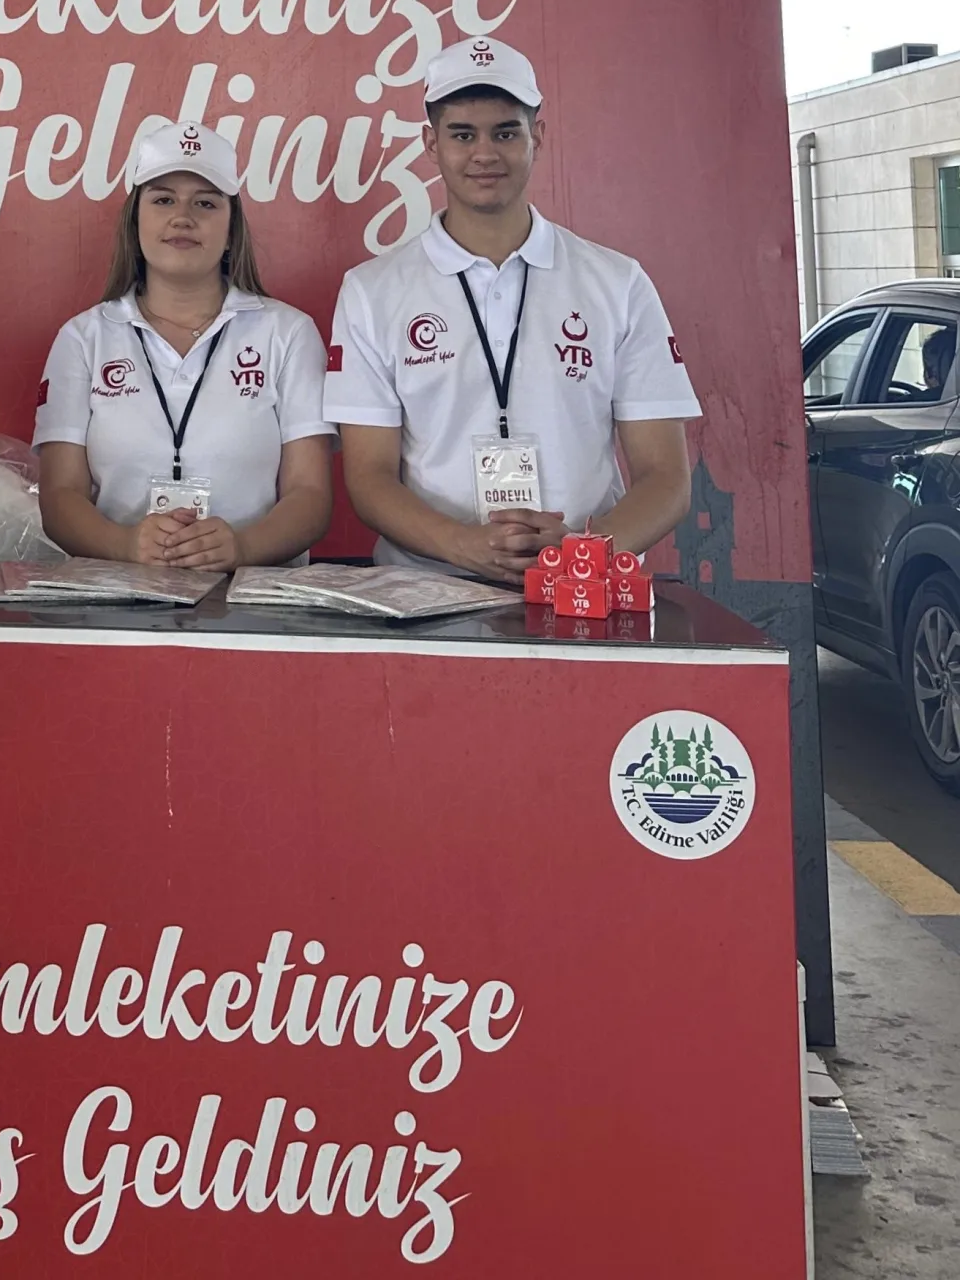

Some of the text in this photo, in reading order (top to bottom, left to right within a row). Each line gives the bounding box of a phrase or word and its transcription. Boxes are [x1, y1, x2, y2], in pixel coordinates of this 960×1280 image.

[469, 52, 495, 61] YTB
[178, 140, 202, 151] YTB
[554, 343, 593, 368] YTB
[230, 370, 264, 388] YTB
[519, 464, 533, 472] YTB
[485, 487, 533, 503] GÖREVLİ
[541, 586, 554, 596] YT
[572, 598, 590, 609] YTB
[616, 593, 634, 603] YTB
[638, 816, 695, 848] Edirne
[696, 789, 746, 845] Valiliği
[63, 1085, 472, 1265] Geldiniz
